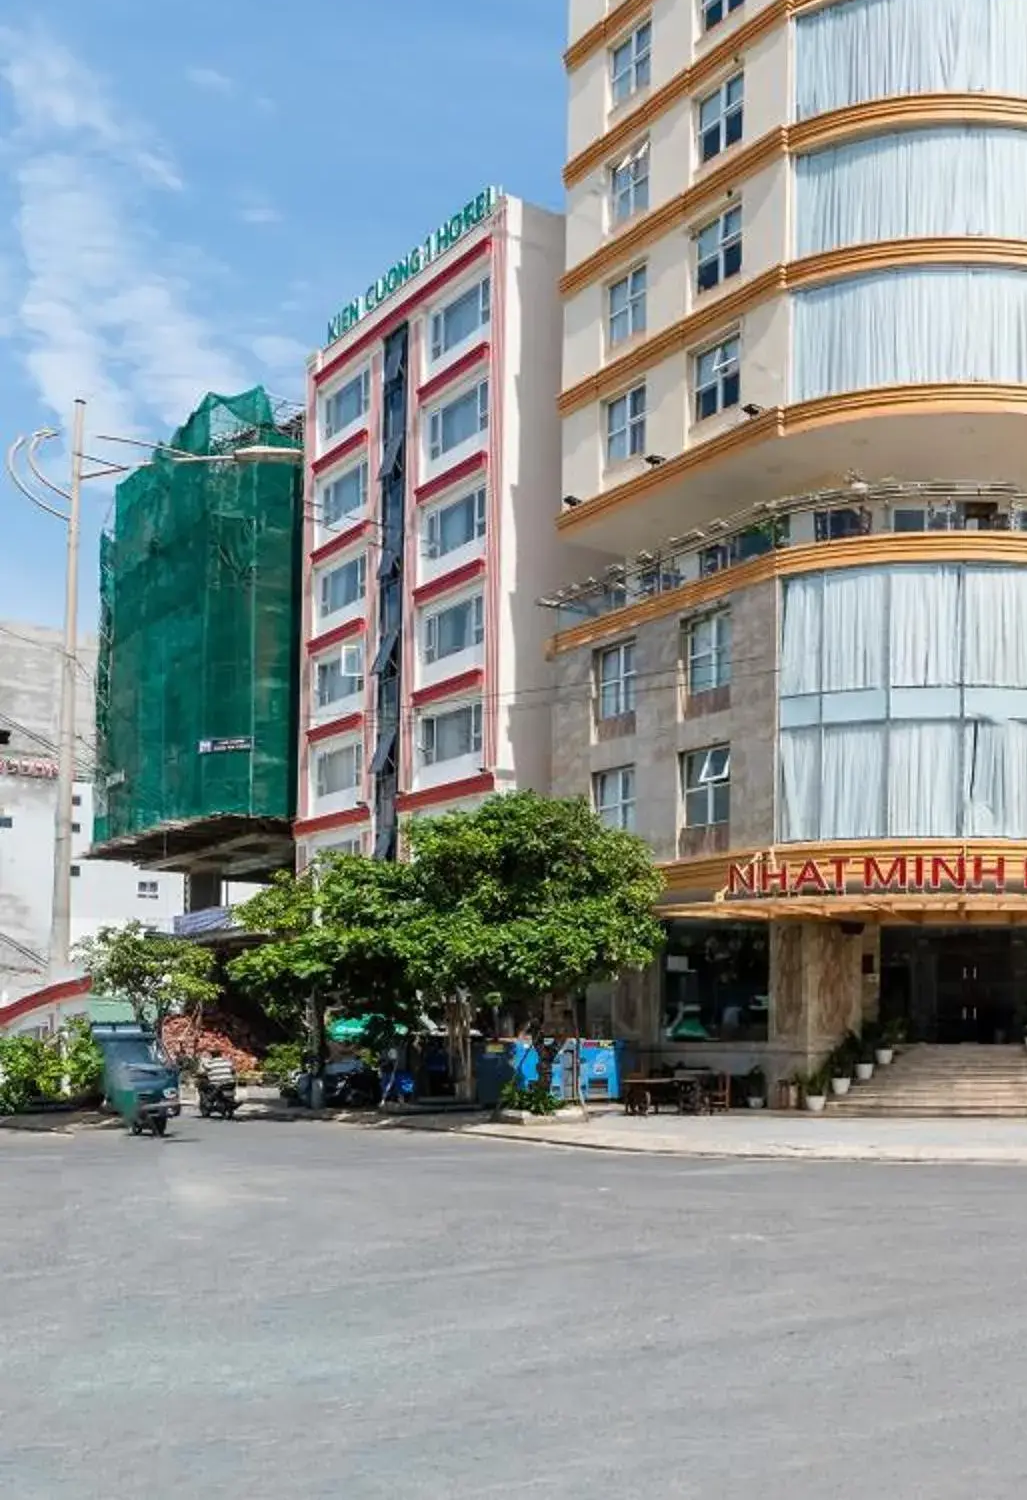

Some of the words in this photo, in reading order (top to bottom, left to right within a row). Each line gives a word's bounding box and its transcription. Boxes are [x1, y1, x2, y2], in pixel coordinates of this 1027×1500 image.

[327, 297, 361, 344] KIEN
[436, 185, 494, 254] HOTEL
[728, 856, 850, 895] NHAT
[863, 855, 1005, 889] MINH
